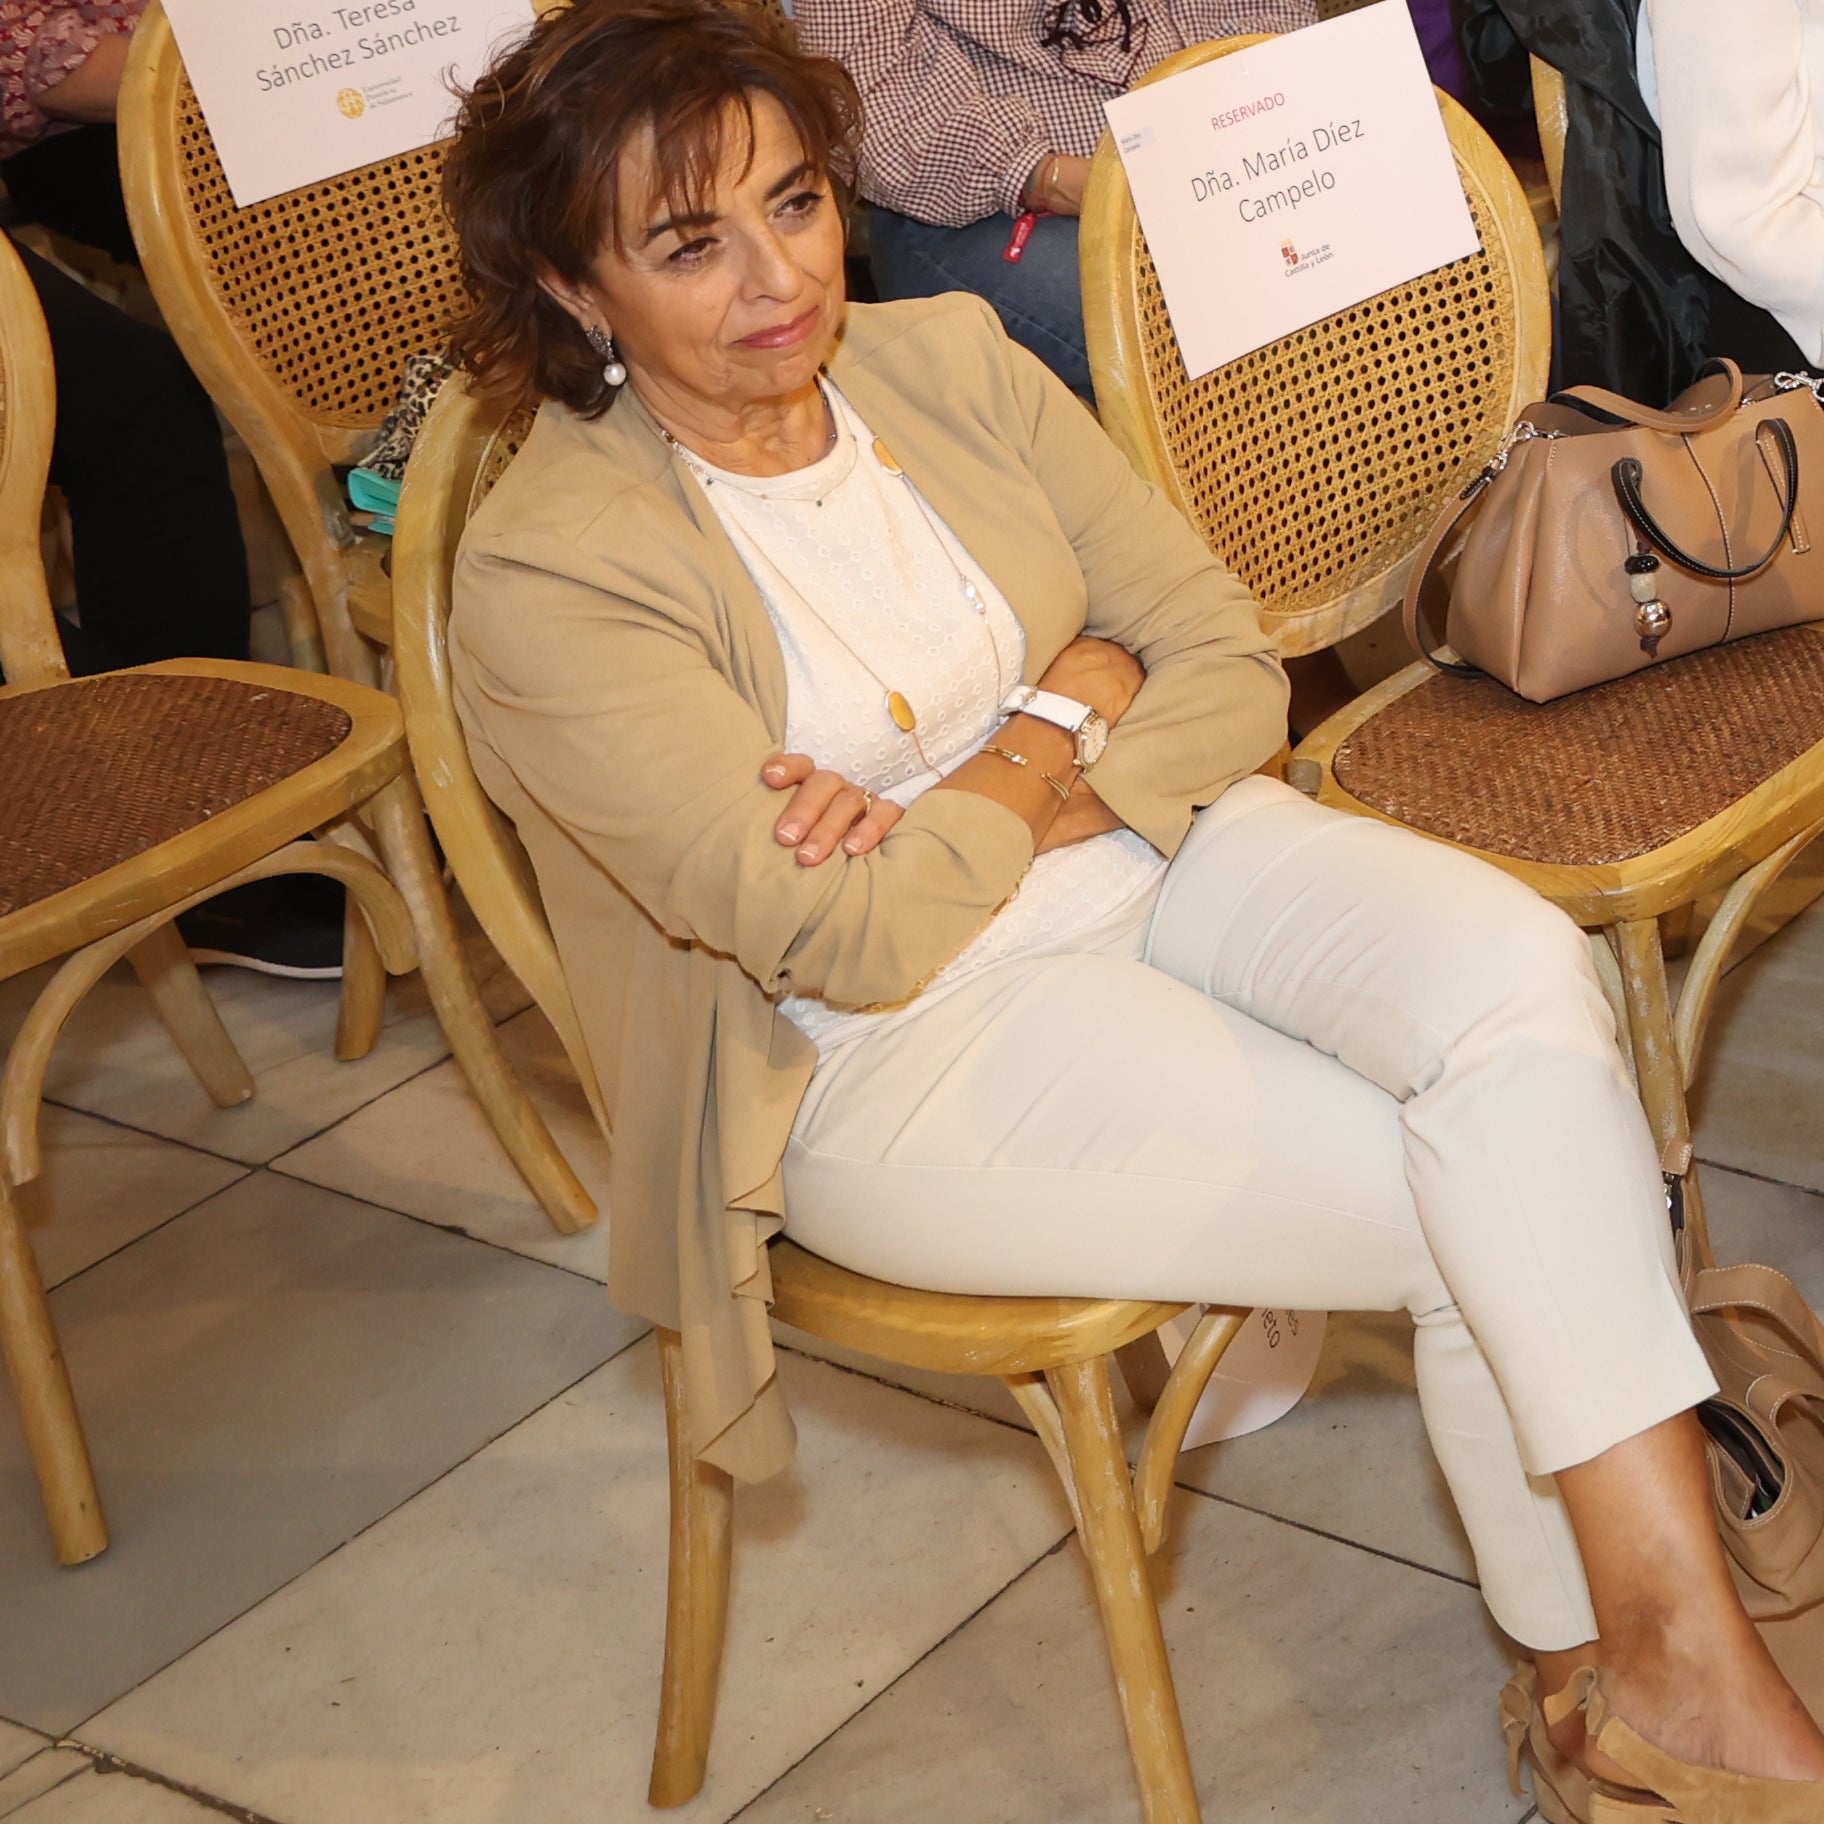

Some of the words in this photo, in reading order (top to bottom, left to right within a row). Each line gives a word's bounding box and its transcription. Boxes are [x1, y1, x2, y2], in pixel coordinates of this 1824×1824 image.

[256, 49, 355, 92] Sánchez
[358, 16, 462, 60] Sánchez
[273, 21, 331, 50] Dña.
[1211, 92, 1286, 132] RESERVADO
[1190, 169, 1240, 203] Dña.
[1242, 137, 1309, 180] María
[1312, 119, 1365, 152] Díez
[1238, 169, 1336, 223] Campelo
